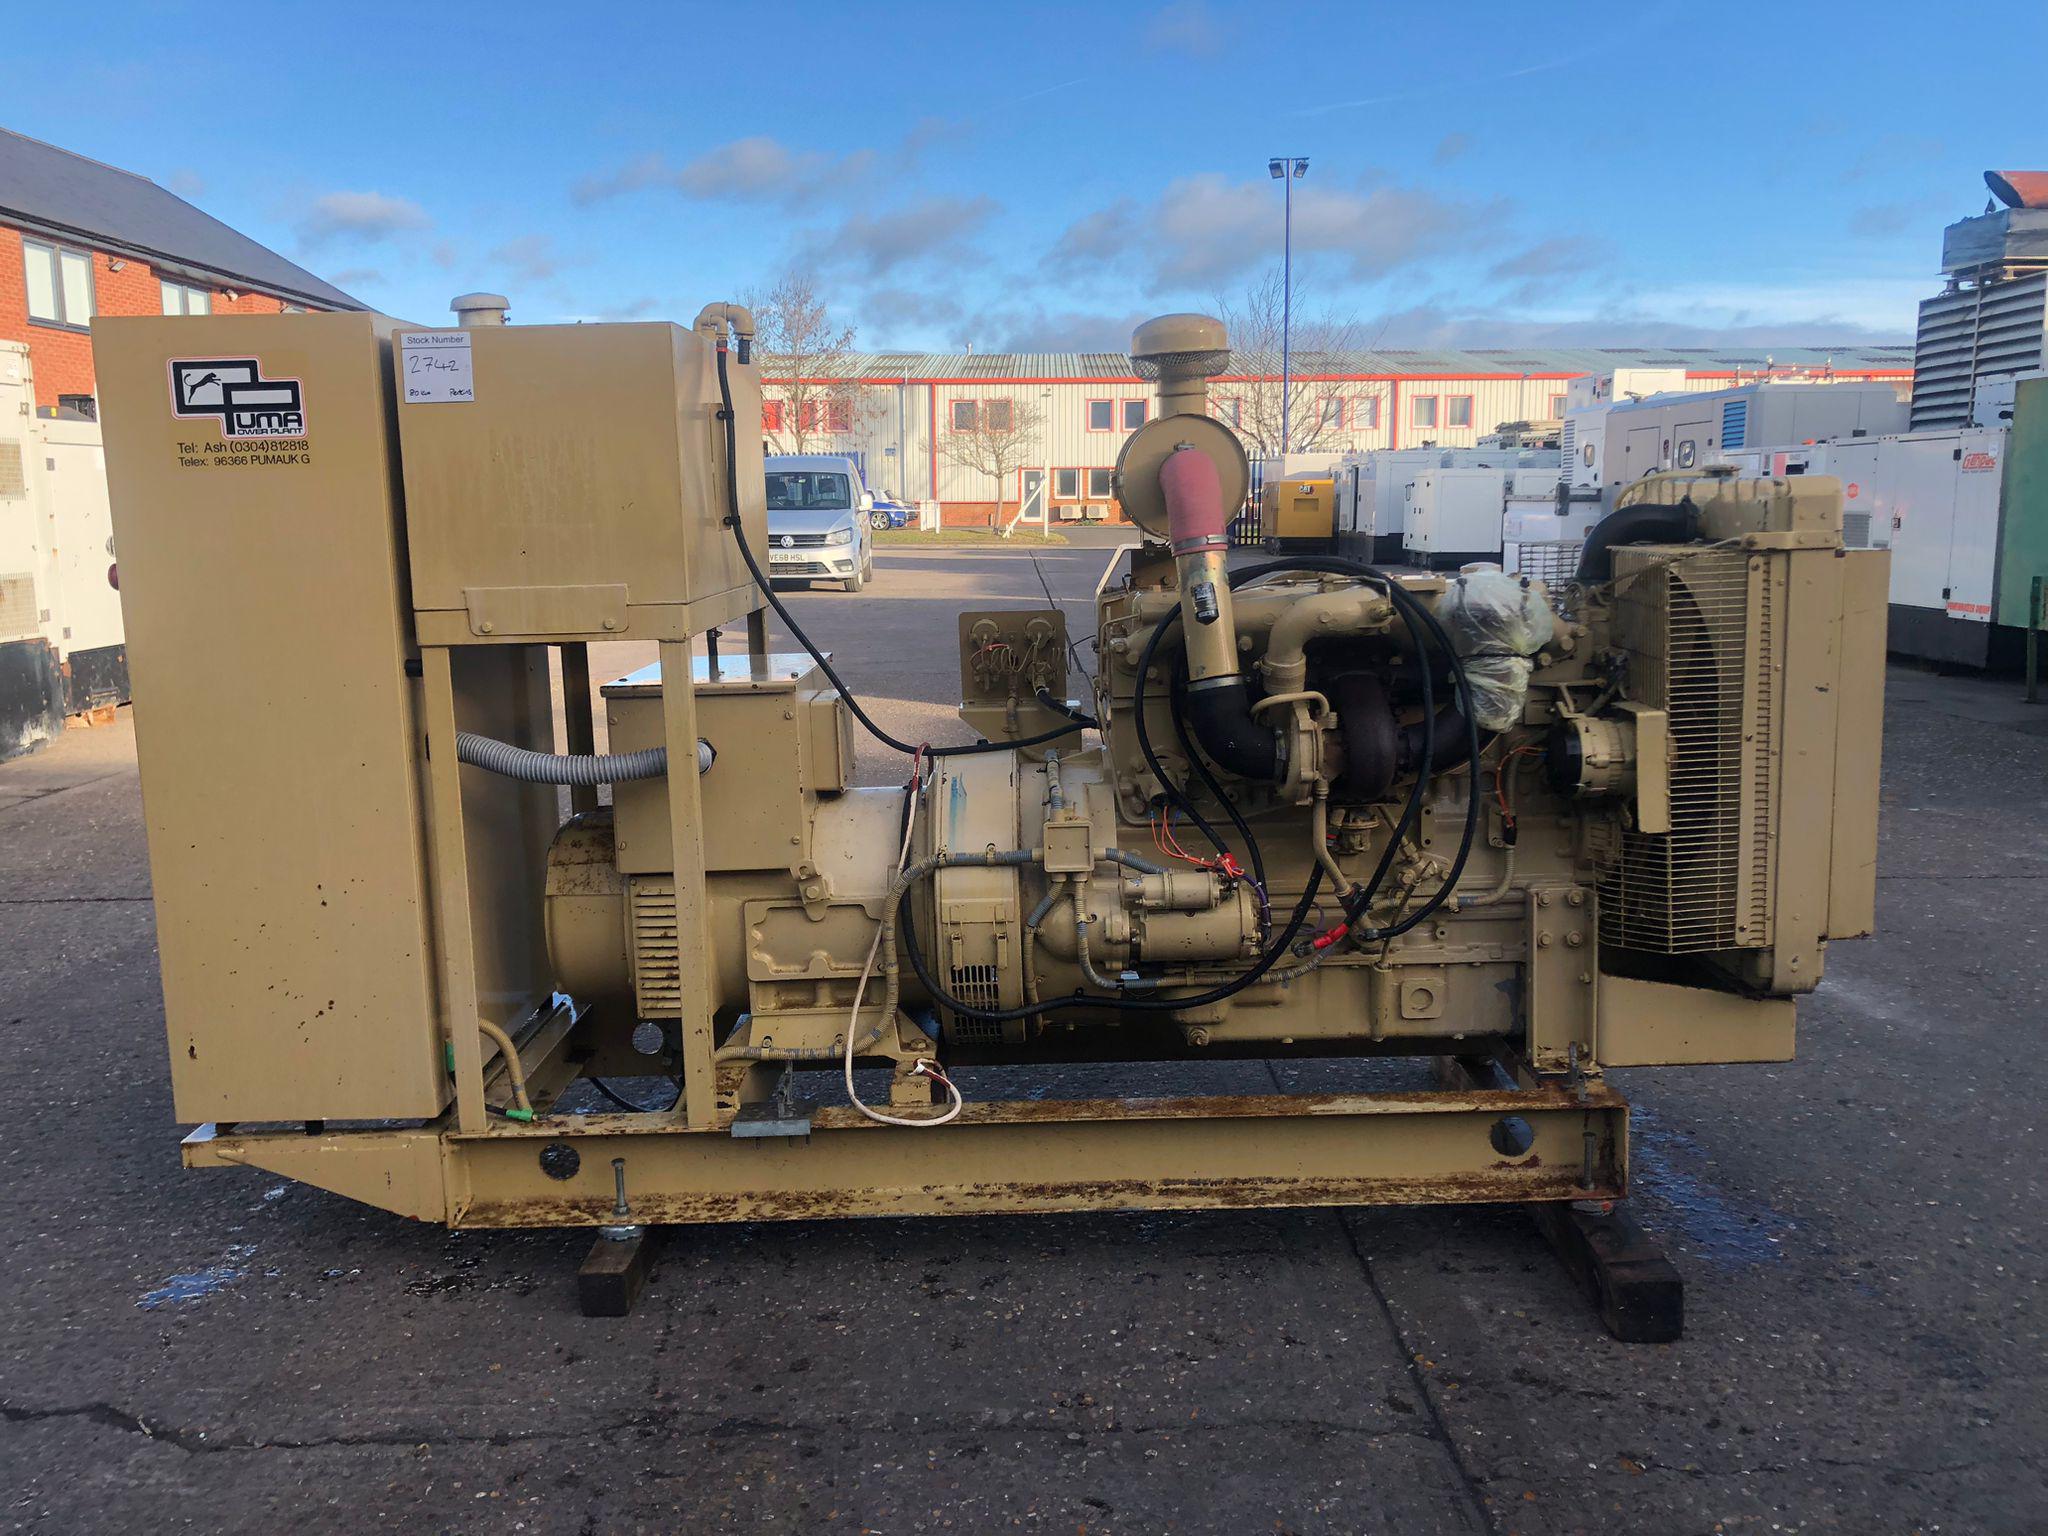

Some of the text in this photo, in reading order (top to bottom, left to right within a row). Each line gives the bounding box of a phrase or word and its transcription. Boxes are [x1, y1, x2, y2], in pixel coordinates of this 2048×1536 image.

[407, 335, 464, 344] Stock Number
[409, 355, 459, 373] 2742
[270, 427, 303, 435] PLANT
[177, 442, 198, 454] Tel:
[204, 442, 227, 453] Ash
[178, 454, 310, 467] Telex: 96366 PUMAUK G
